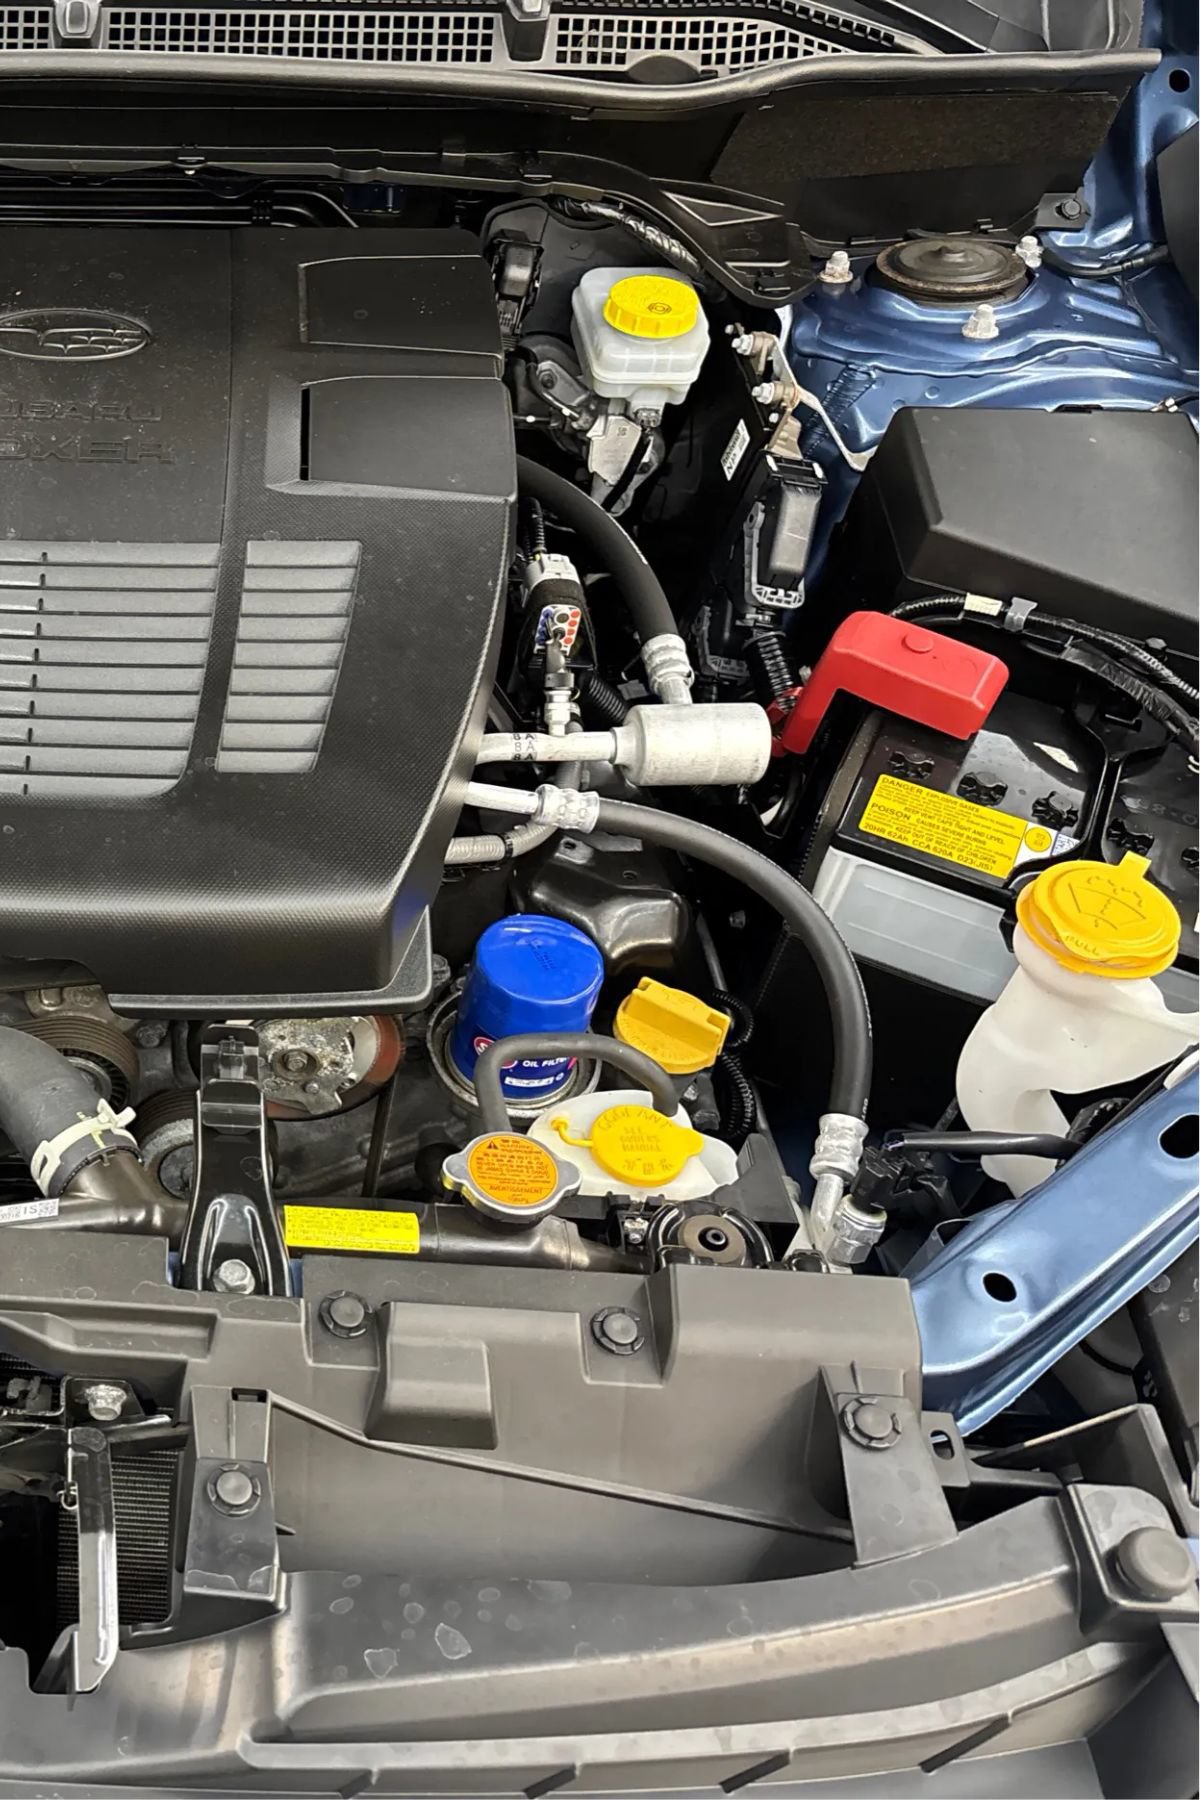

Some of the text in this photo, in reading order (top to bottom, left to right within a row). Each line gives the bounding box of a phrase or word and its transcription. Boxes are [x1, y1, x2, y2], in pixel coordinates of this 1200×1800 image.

[881, 776, 924, 796] DANGER
[871, 802, 911, 821] POISON
[911, 839, 932, 850] CCA
[522, 1060, 540, 1068] OIL
